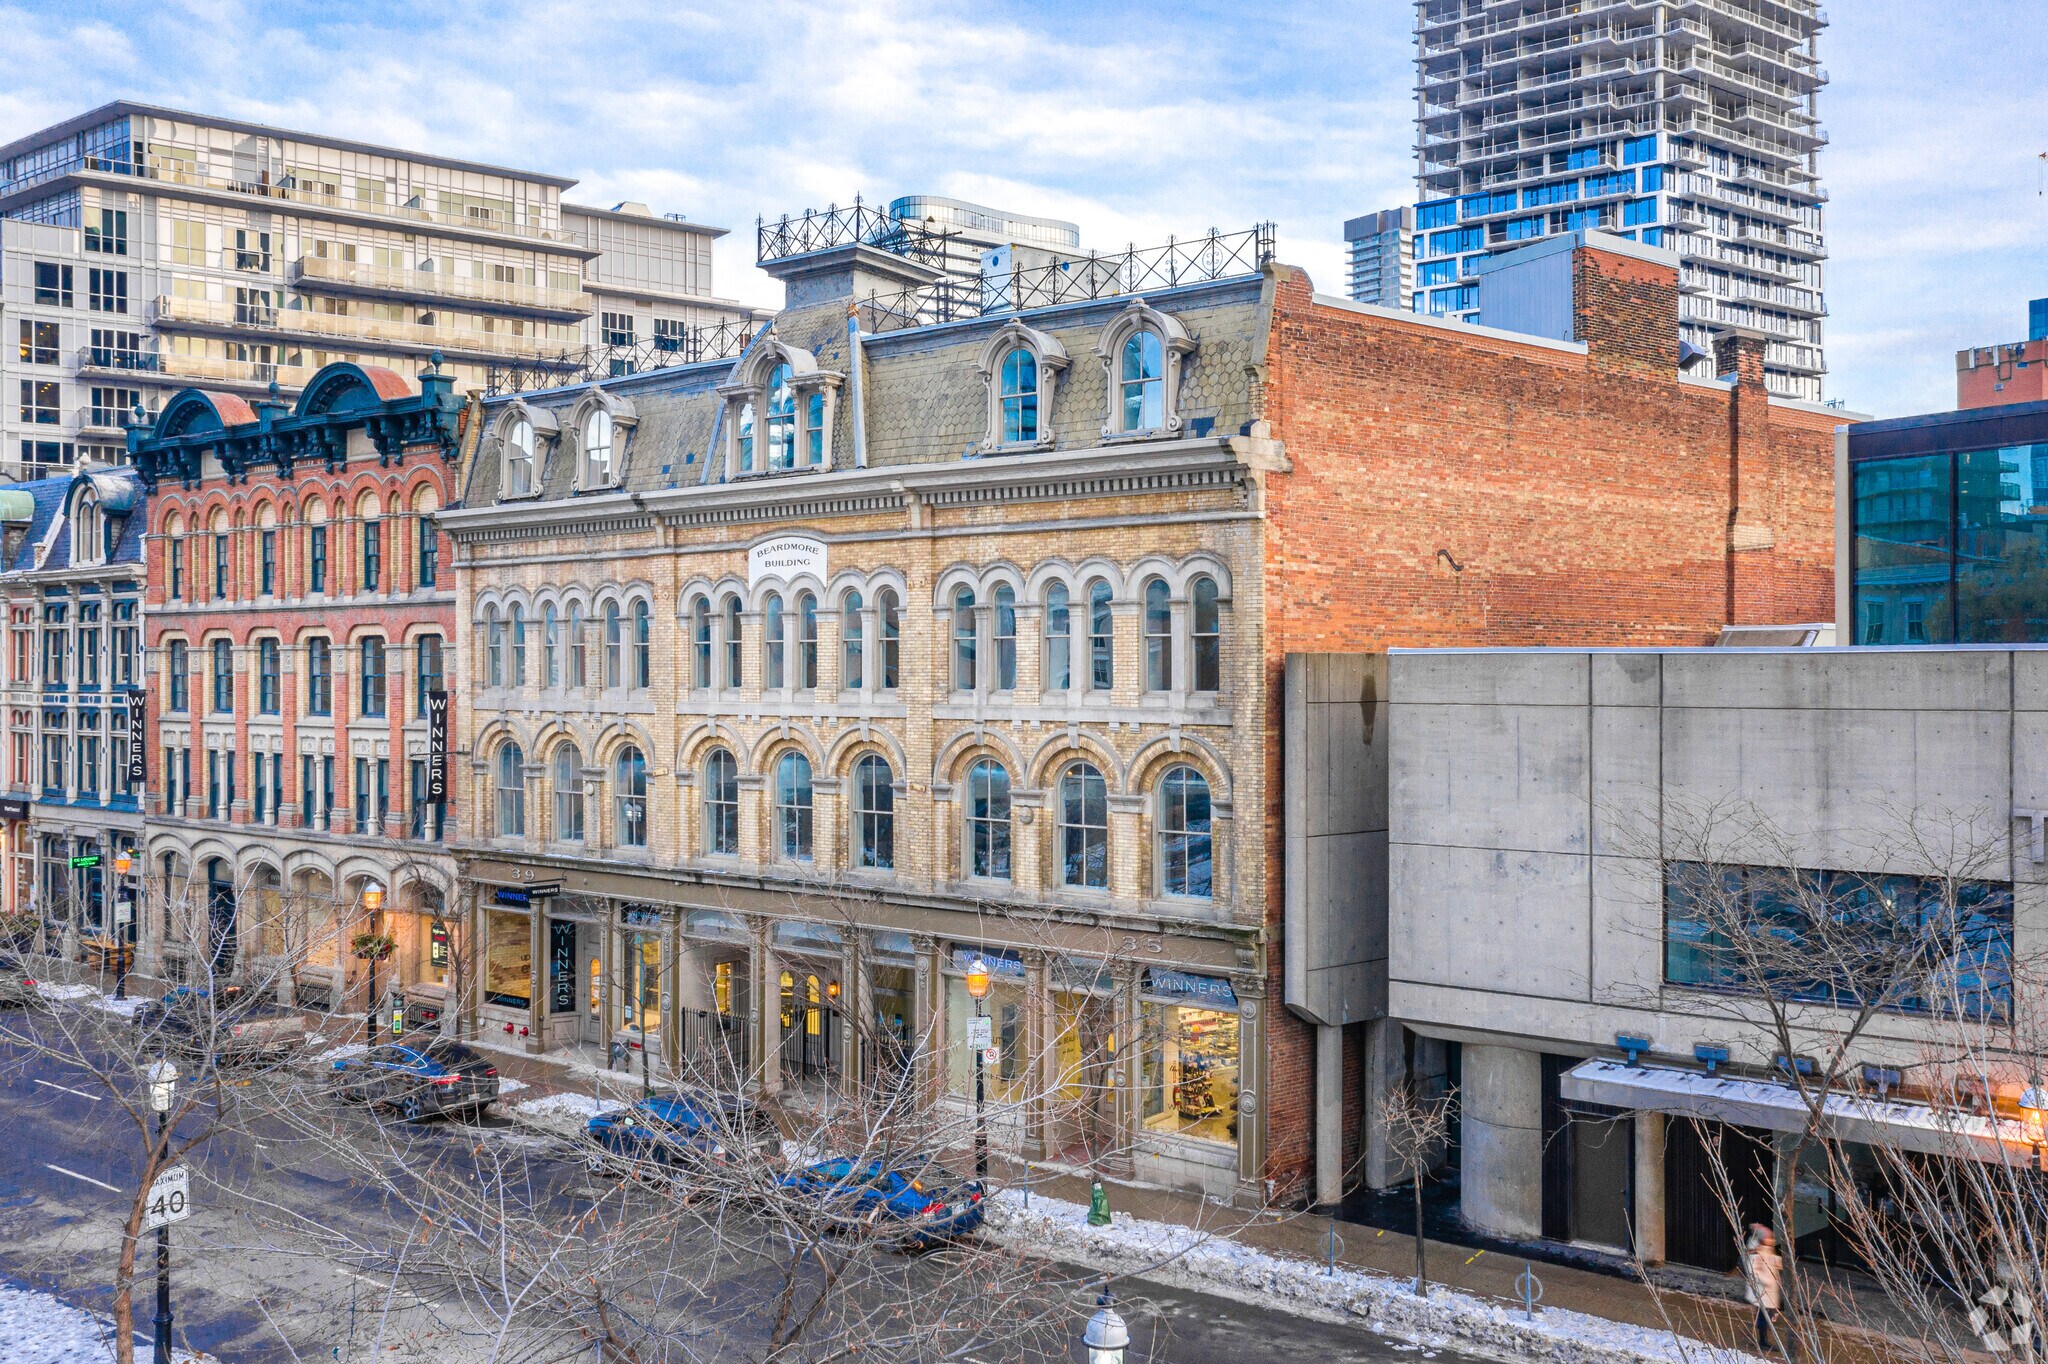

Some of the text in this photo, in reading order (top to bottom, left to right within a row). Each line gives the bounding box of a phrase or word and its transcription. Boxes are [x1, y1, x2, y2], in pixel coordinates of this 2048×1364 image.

[757, 543, 819, 558] BEARDMORE
[765, 559, 810, 567] BUILDING
[129, 696, 145, 776] WINNERS
[430, 699, 446, 795] WINNERS
[512, 868, 534, 880] 39
[497, 891, 529, 902] WINNER
[532, 887, 558, 895] WINNERS
[1122, 936, 1162, 953] 35
[555, 924, 571, 1005] WINNERS
[964, 954, 1021, 970] WNNERS
[1151, 979, 1232, 998] WINNERS
[497, 996, 525, 1006] WINNERS
[155, 1173, 184, 1186] AXIMUM
[151, 1190, 184, 1217] 40
